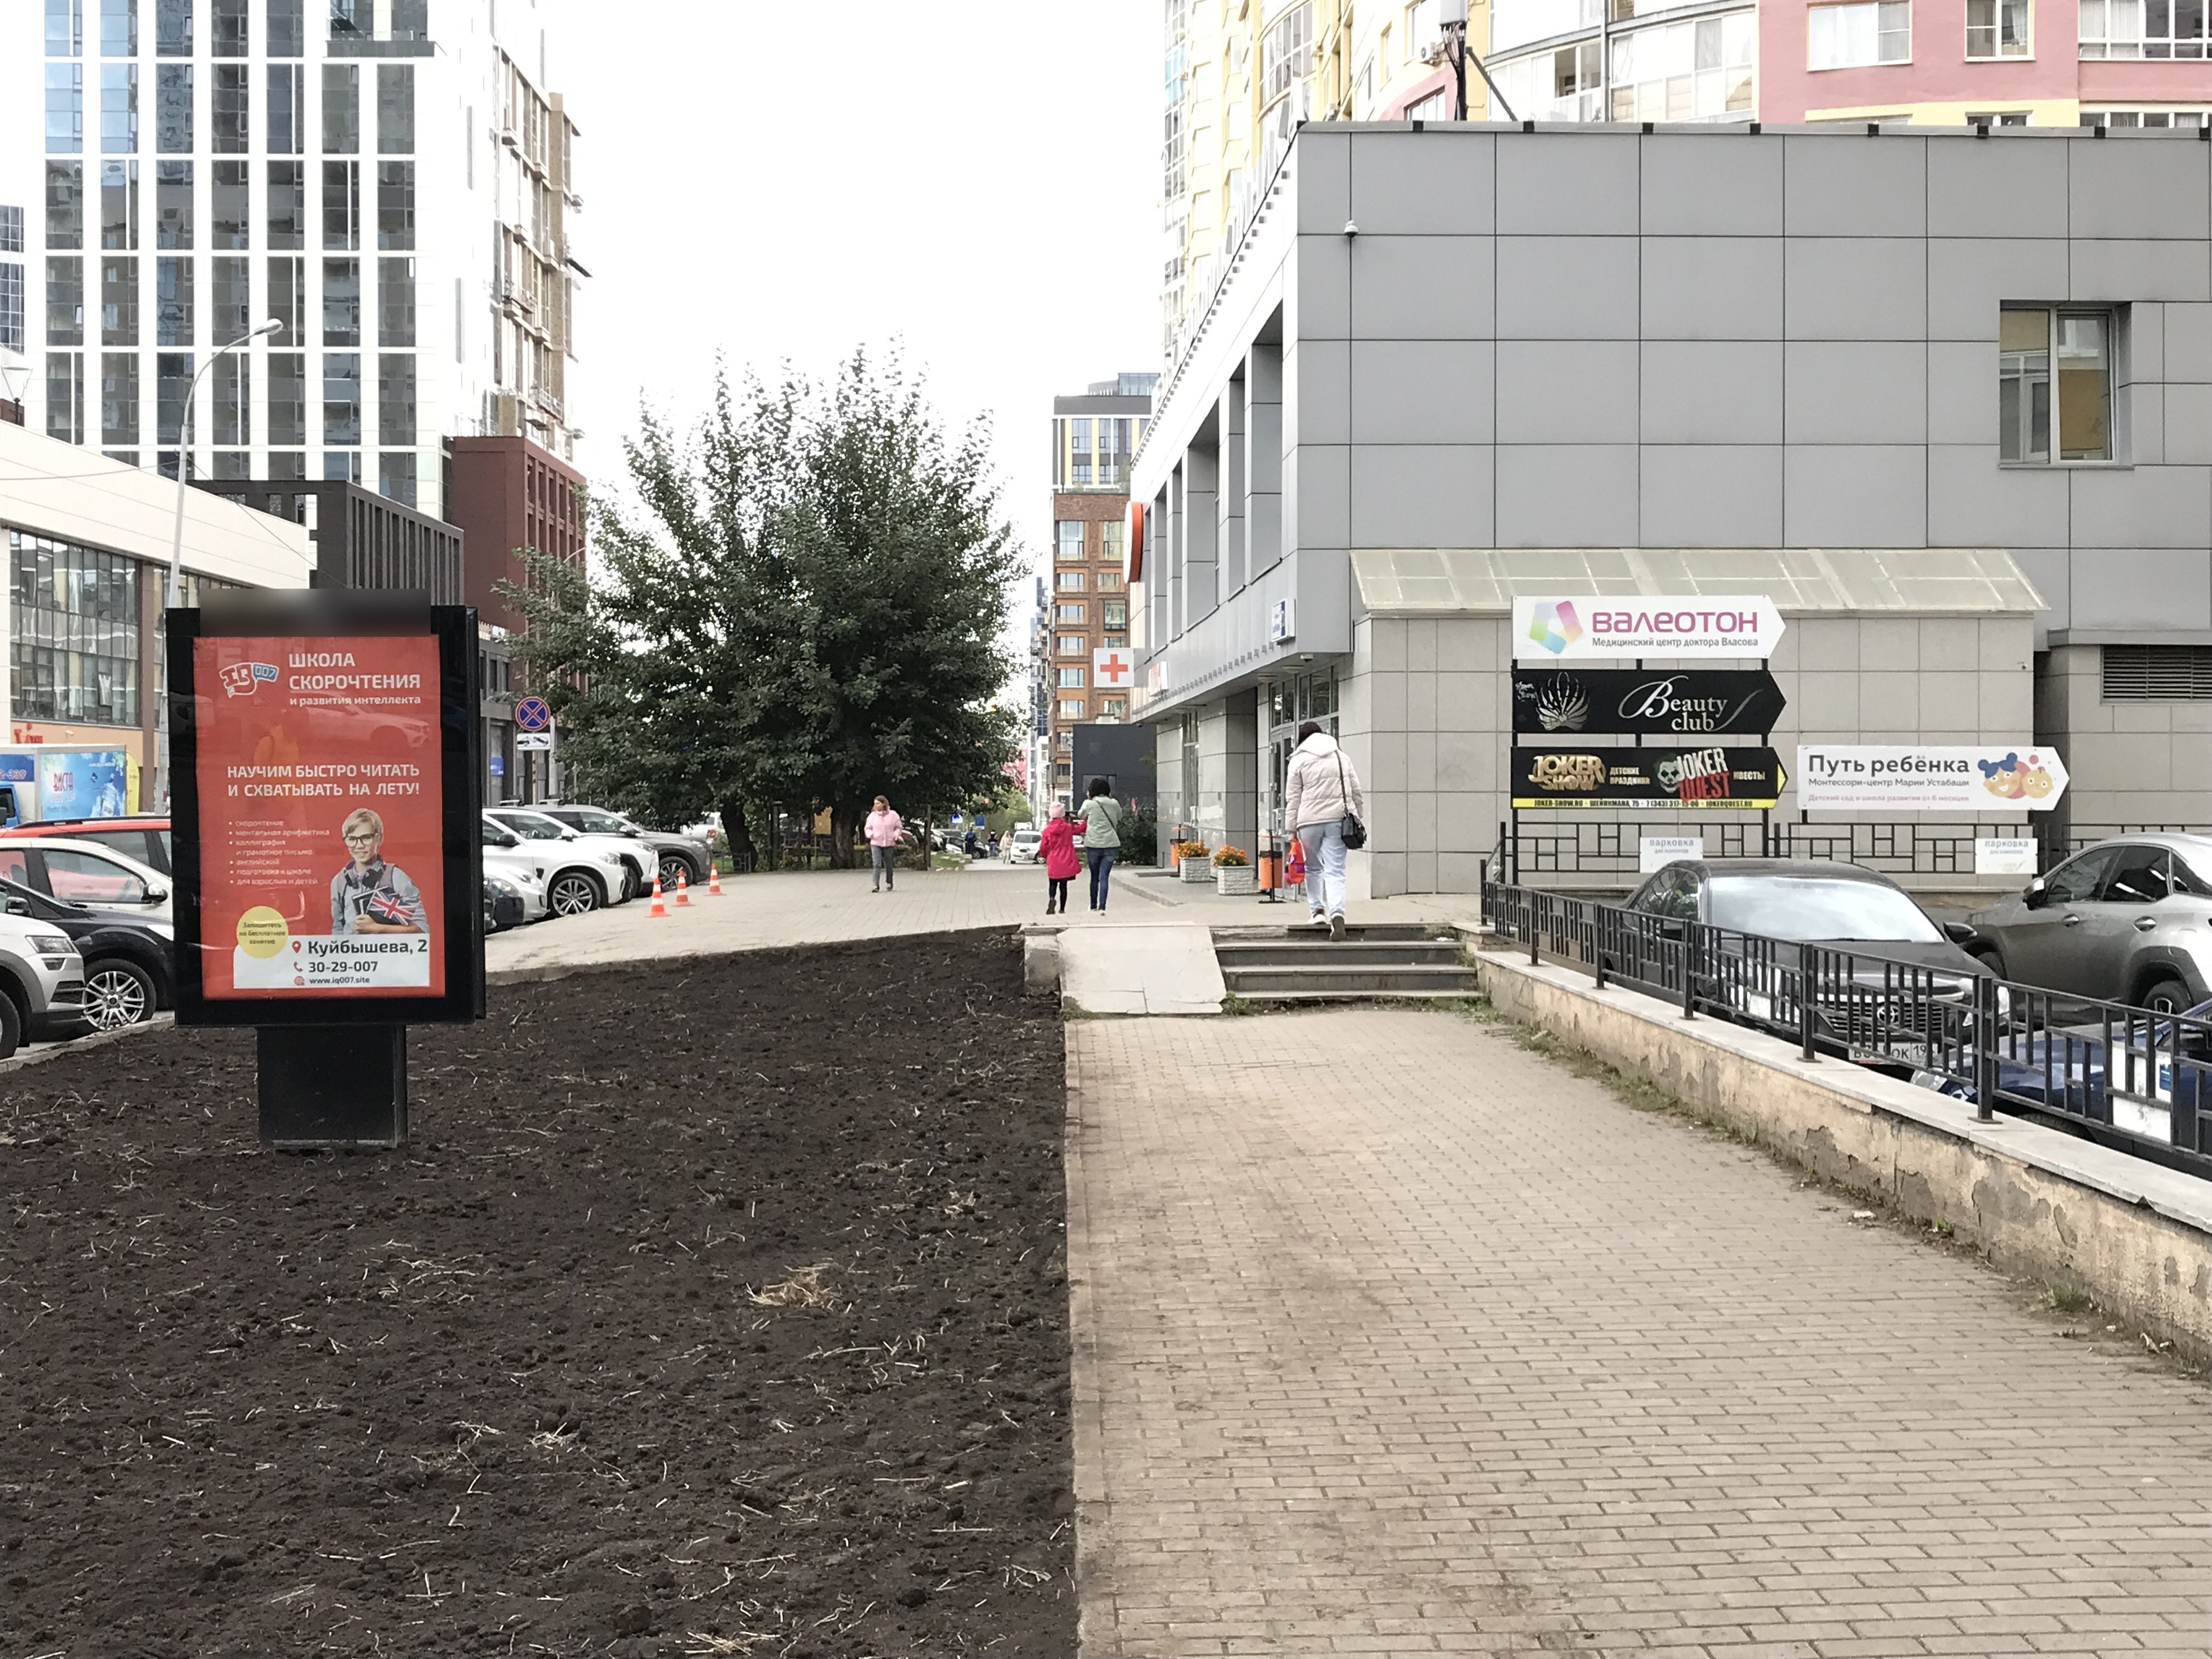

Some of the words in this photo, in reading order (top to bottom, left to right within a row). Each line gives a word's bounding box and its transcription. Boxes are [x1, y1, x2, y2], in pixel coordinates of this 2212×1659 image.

[1592, 637, 1654, 647] Медицинский
[1656, 639, 1681, 648] центр
[1684, 638, 1719, 647] доктора
[1722, 637, 1758, 647] Власова
[289, 653, 356, 668] ШКОЛА
[255, 665, 276, 678] 007
[289, 674, 421, 690] СКОРОЧТЕНИЯ
[300, 697, 352, 707] развития
[354, 697, 421, 705] интеллекта
[1618, 675, 1728, 719] Beauty
[1671, 712, 1715, 732] club
[228, 766, 292, 778] НАУЧИМ
[296, 765, 357, 777] БЫСТРО
[361, 764, 420, 777] ЧИТАТЬ
[1528, 755, 1605, 783] JOKER
[1676, 748, 1728, 780] JOKER
[1809, 754, 1865, 777] Путь
[1871, 754, 1970, 777] ребёнка
[228, 785, 238, 797] И
[244, 783, 343, 797] СХВАТЫВАТЬ
[349, 783, 370, 795] НА
[376, 782, 420, 795] ЛЕТУ!
[1541, 775, 1598, 791] SHOW
[1678, 771, 1730, 802] QUEST
[1808, 778, 1893, 787] Монтессори-центр
[1895, 778, 1925, 787] Марии
[1927, 778, 1970, 787] Устабаши
[1649, 839, 1695, 848] парковка
[1985, 840, 2029, 848] парковка
[308, 940, 414, 957] Куйбышева,
[417, 939, 427, 952] 2
[308, 961, 378, 973] 30-29-007
[309, 977, 370, 985] www.iq007.site
